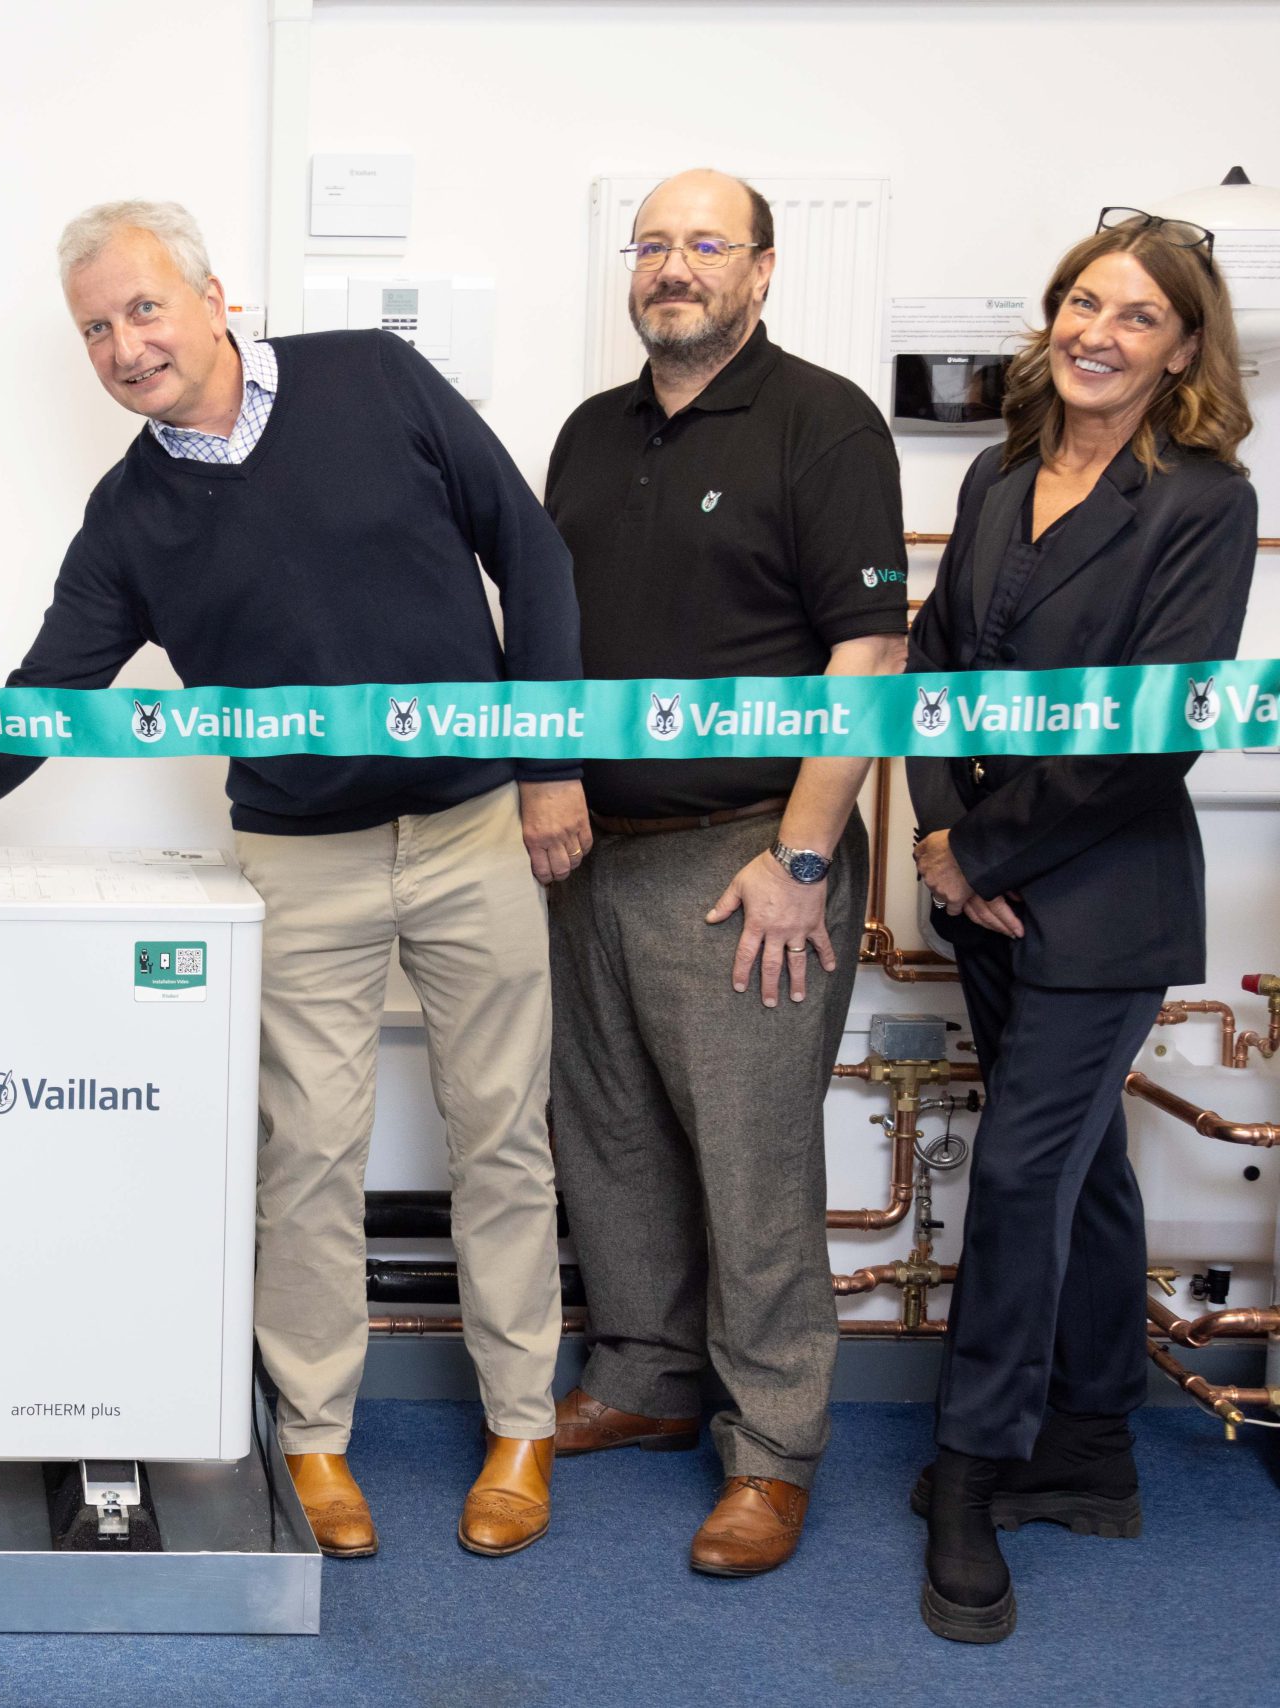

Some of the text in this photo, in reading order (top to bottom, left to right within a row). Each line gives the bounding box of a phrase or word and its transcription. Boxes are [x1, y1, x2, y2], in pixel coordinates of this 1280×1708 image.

[994, 300, 1024, 309] Vaillant
[171, 706, 325, 740] Vaillant
[426, 703, 584, 739] Vaillant
[690, 702, 850, 737] Vaillant
[957, 694, 1120, 732] Vaillant
[1225, 684, 1279, 723] Va
[22, 1078, 160, 1111] Vaillant
[11, 1403, 121, 1420] aroTHERM plus
